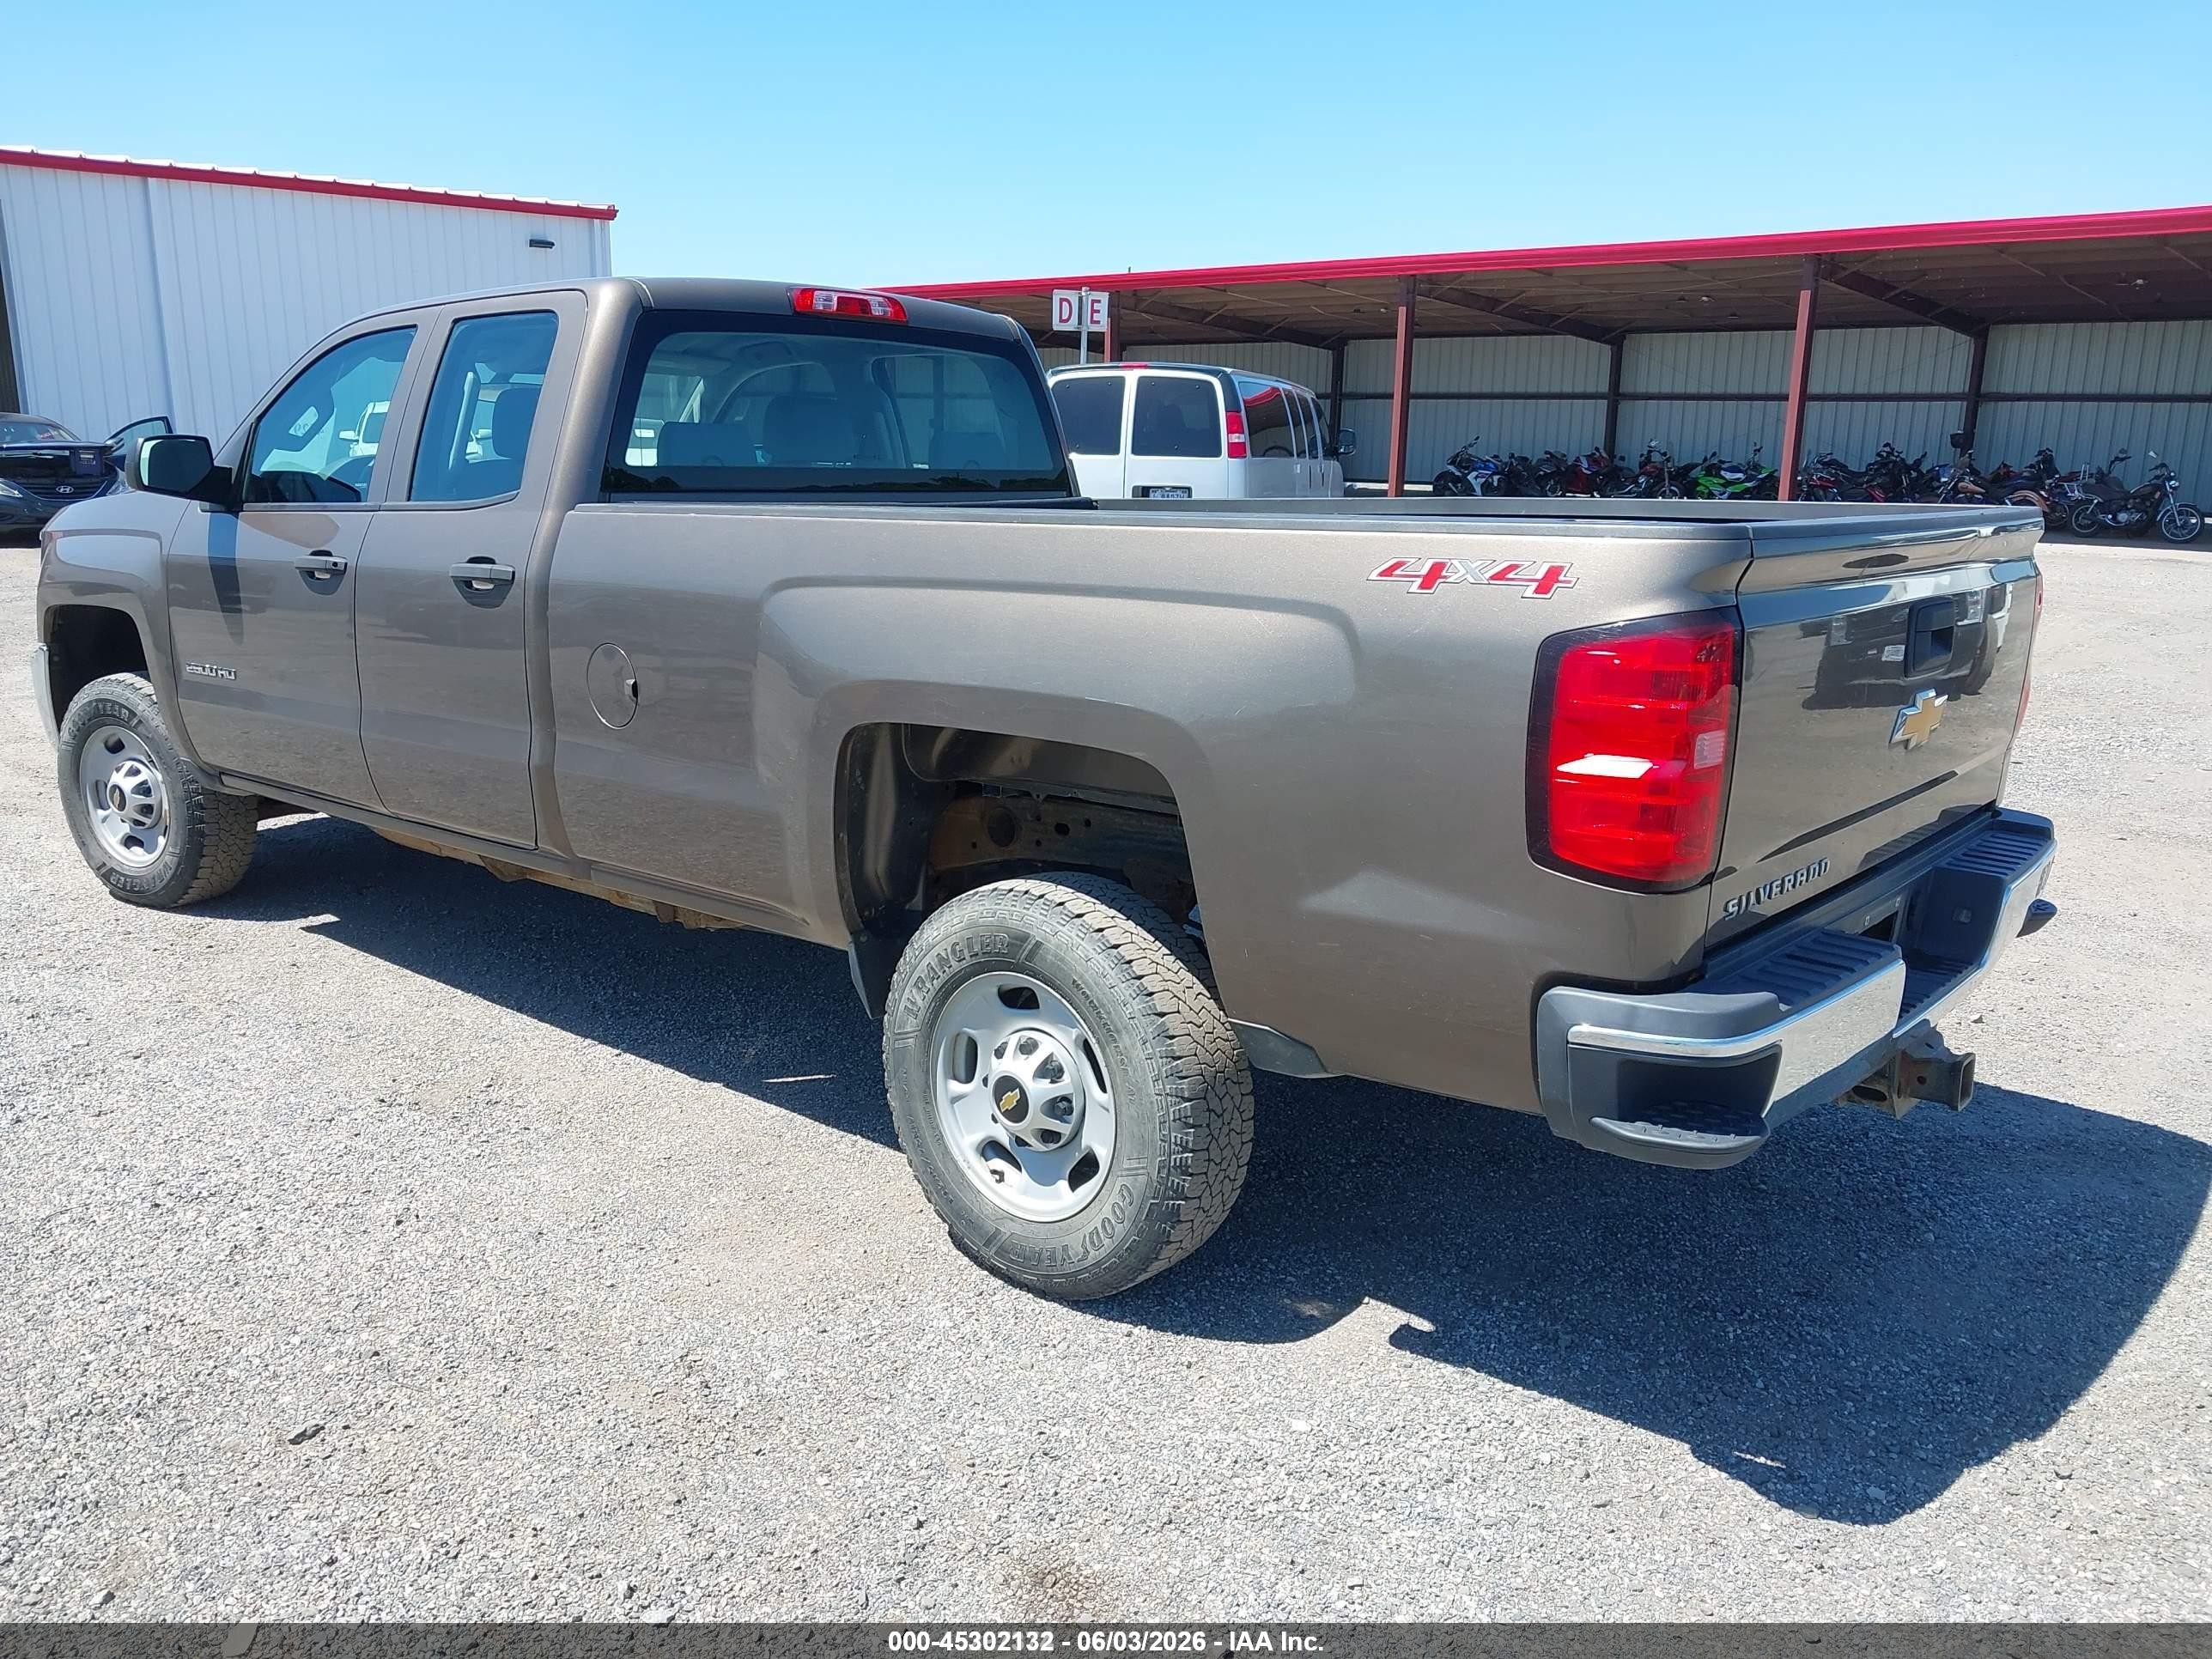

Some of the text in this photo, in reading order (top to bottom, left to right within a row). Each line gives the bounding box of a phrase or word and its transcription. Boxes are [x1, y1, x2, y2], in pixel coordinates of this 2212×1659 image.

[1058, 297, 1073, 325] D
[1090, 299, 1102, 325] E
[1723, 857, 1831, 921] SILVERADO
[902, 933, 1010, 1020] WRANGLER
[1008, 1182, 1134, 1267] GOODYEAR
